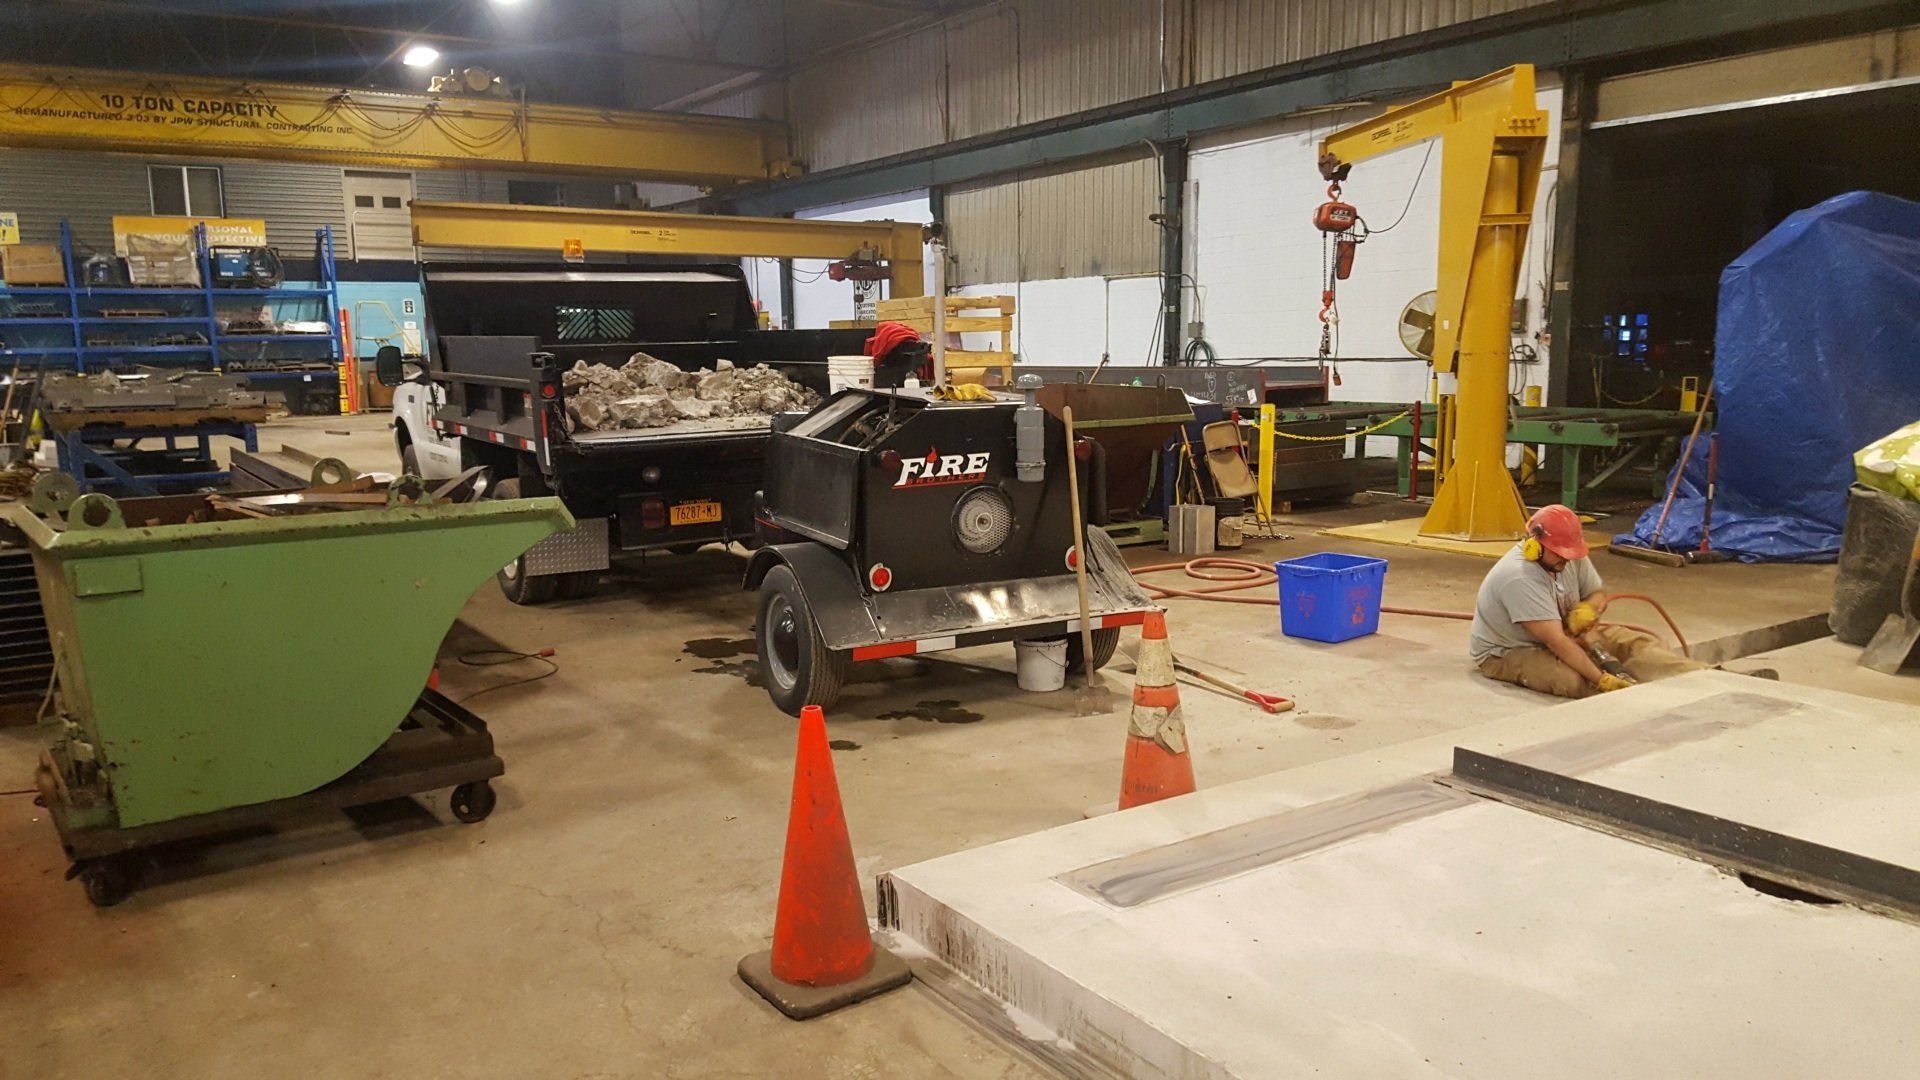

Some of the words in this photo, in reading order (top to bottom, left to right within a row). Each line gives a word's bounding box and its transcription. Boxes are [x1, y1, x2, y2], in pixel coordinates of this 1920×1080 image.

[100, 94, 125, 109] 10
[134, 95, 174, 112] TON
[184, 99, 277, 118] CAPACITY
[154, 116, 167, 124] BY
[170, 117, 193, 125] JPW
[197, 118, 261, 129] STRUCTURAL
[266, 122, 333, 133] CONTRACTING
[207, 225, 253, 234] RSONAL
[209, 234, 265, 243] OTECTIVE
[905, 472, 985, 485] BROTHERS
